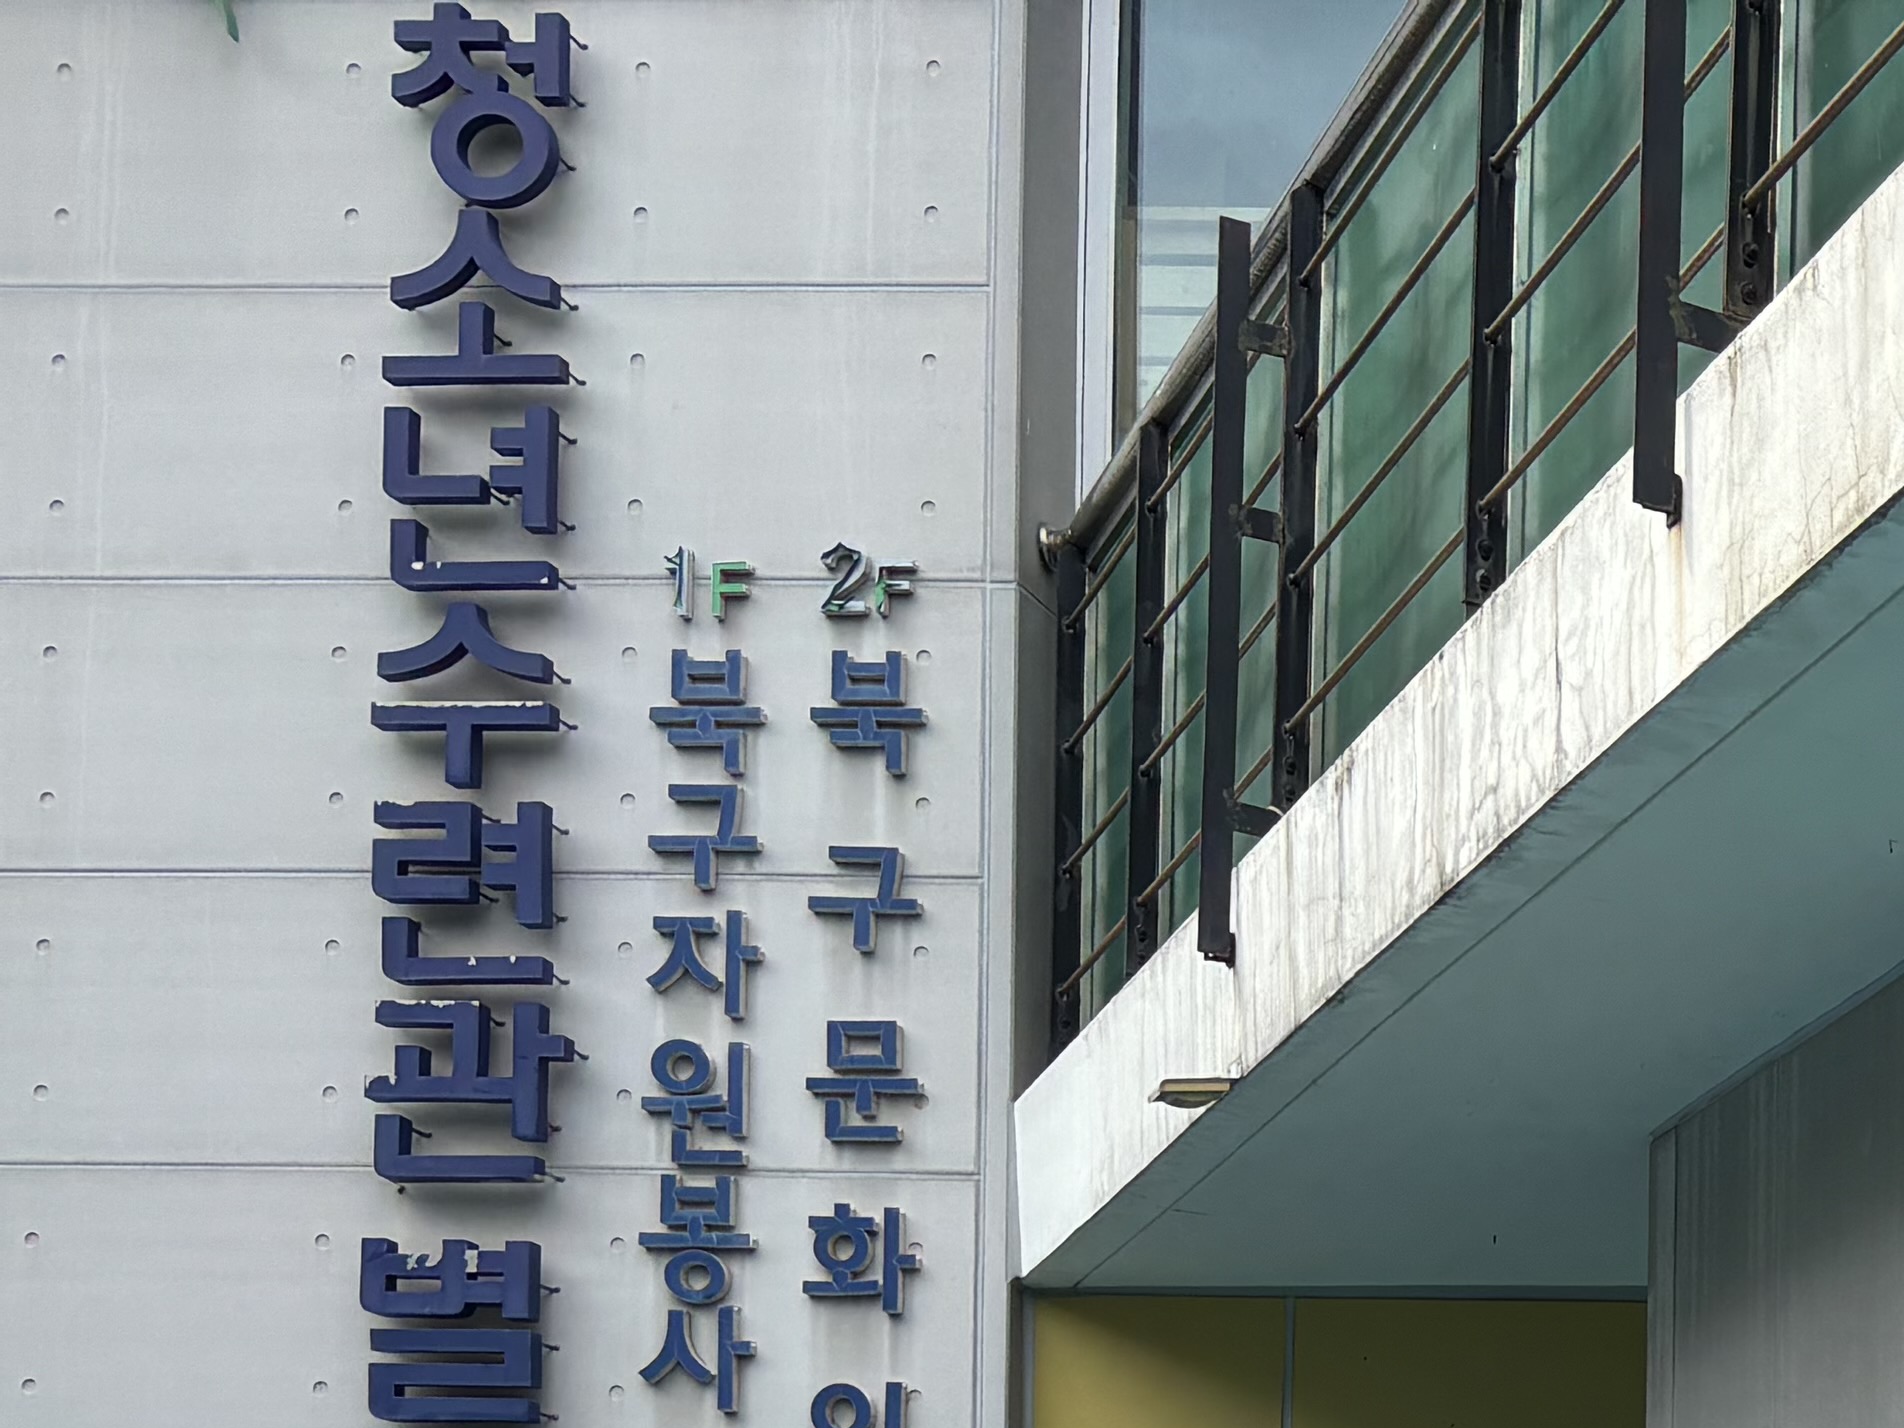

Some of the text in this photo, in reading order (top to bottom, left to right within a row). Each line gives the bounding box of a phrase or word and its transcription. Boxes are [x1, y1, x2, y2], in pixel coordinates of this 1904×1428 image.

[364, 2, 578, 1182] 청소년수련관
[663, 544, 758, 621] 1F
[819, 541, 920, 618] 2F
